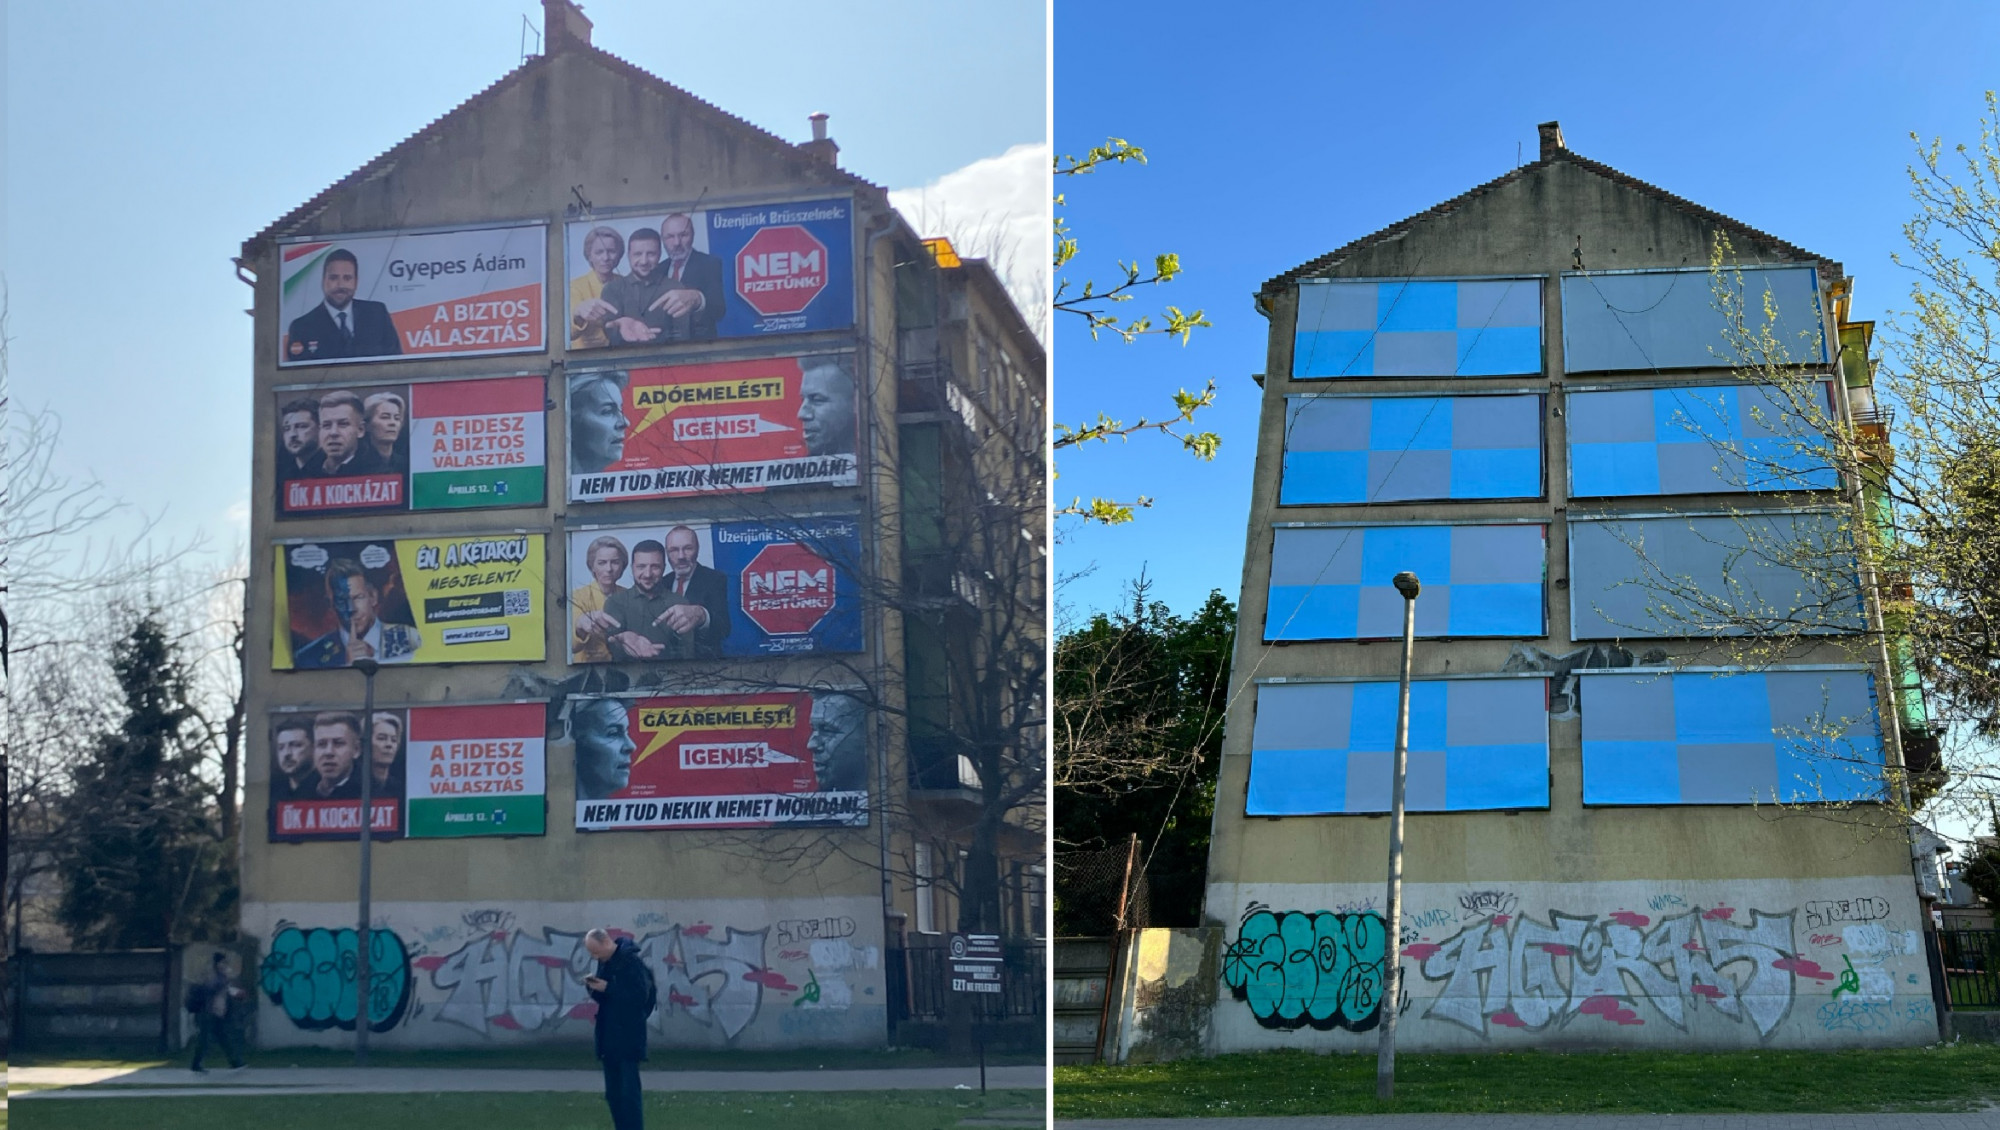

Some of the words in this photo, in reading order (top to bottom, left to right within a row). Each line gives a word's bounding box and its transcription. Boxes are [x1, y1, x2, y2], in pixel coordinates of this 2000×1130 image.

[714, 211, 766, 230] Üzenjünk
[770, 206, 845, 225] Brüsszelnek:
[389, 259, 466, 281] Gyepes
[472, 253, 526, 272] Ádám
[743, 250, 820, 278] NEM
[743, 276, 820, 293] FIZETÜNK!
[433, 305, 449, 323] A
[454, 299, 530, 322] BIZTOS
[406, 320, 530, 348] VÁLASZTÁS
[637, 381, 781, 405] ADÓEMELÉST!
[433, 421, 447, 436] A
[452, 416, 524, 435] FIDESZ
[678, 418, 756, 438] IGENIS!
[433, 438, 447, 453] A
[452, 434, 525, 452] BIZTOS
[433, 449, 525, 468] VÁLASZTÁS
[478, 484, 490, 493] 12.
[579, 475, 615, 495] NEM
[620, 473, 651, 493] TUD
[654, 468, 708, 490] NEKIK
[708, 466, 764, 486] NEMET
[312, 486, 323, 505] A
[325, 479, 399, 505] KOCKÁZAT
[718, 528, 773, 545] Üzenjünk
[416, 544, 440, 570] ÉN,
[444, 543, 459, 568] A
[427, 569, 521, 591] MEGJELENT!
[749, 569, 827, 596] NEM
[643, 707, 792, 728] GÁZÁREMELÉST!
[430, 745, 445, 761] A
[451, 742, 524, 760] FIDESZ
[684, 747, 765, 766] IGENIS!
[430, 763, 445, 778] A
[451, 761, 524, 777] BIZTOS
[430, 777, 524, 794] VÁLASZTÁS
[305, 808, 316, 828] A
[584, 804, 620, 823] NEM
[625, 803, 658, 821] TUD
[661, 801, 712, 820] NEKIK
[715, 799, 773, 818] NEMET
